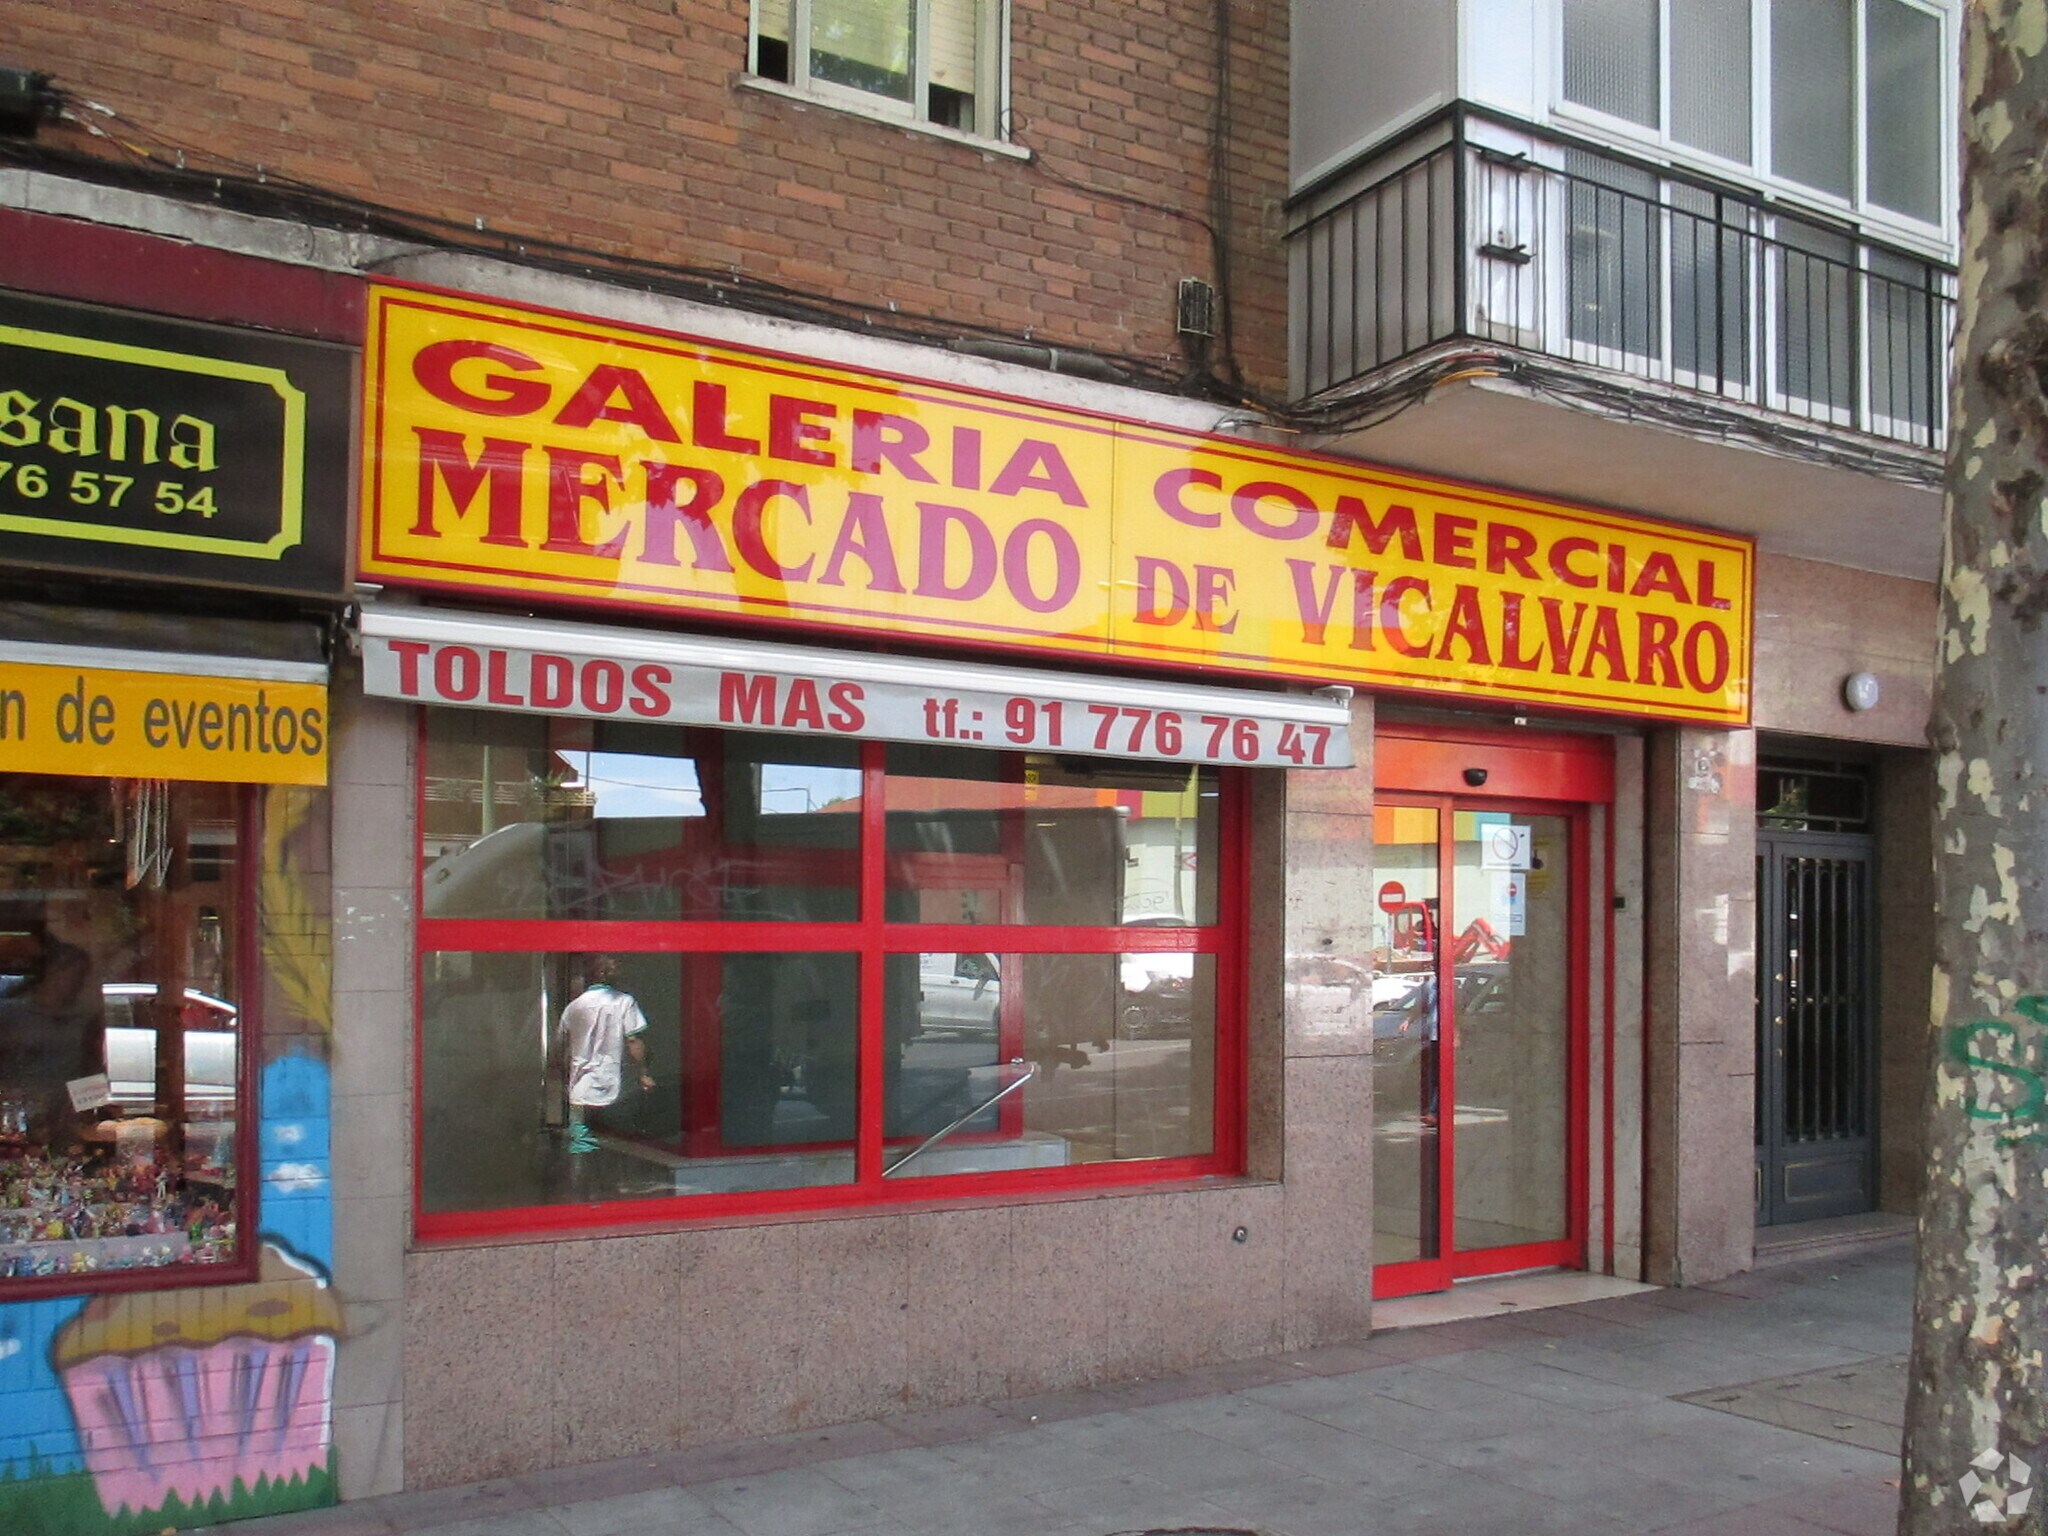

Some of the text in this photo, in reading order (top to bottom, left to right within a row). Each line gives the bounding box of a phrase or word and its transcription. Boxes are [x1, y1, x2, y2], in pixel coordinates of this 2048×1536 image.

[70, 471, 134, 508] 57
[155, 482, 218, 518] 54
[412, 340, 1732, 611] GALERIA COMERCIAL
[408, 426, 1730, 694] MERCADO DE VICALVARO
[57, 676, 115, 746] de
[144, 689, 323, 756] eventos
[388, 640, 672, 717] TOLDOS
[718, 671, 866, 732] MAS
[1005, 697, 1063, 747] 91
[1088, 704, 1183, 756] 776
[1201, 715, 1260, 762] 76
[1277, 723, 1332, 765] 47
